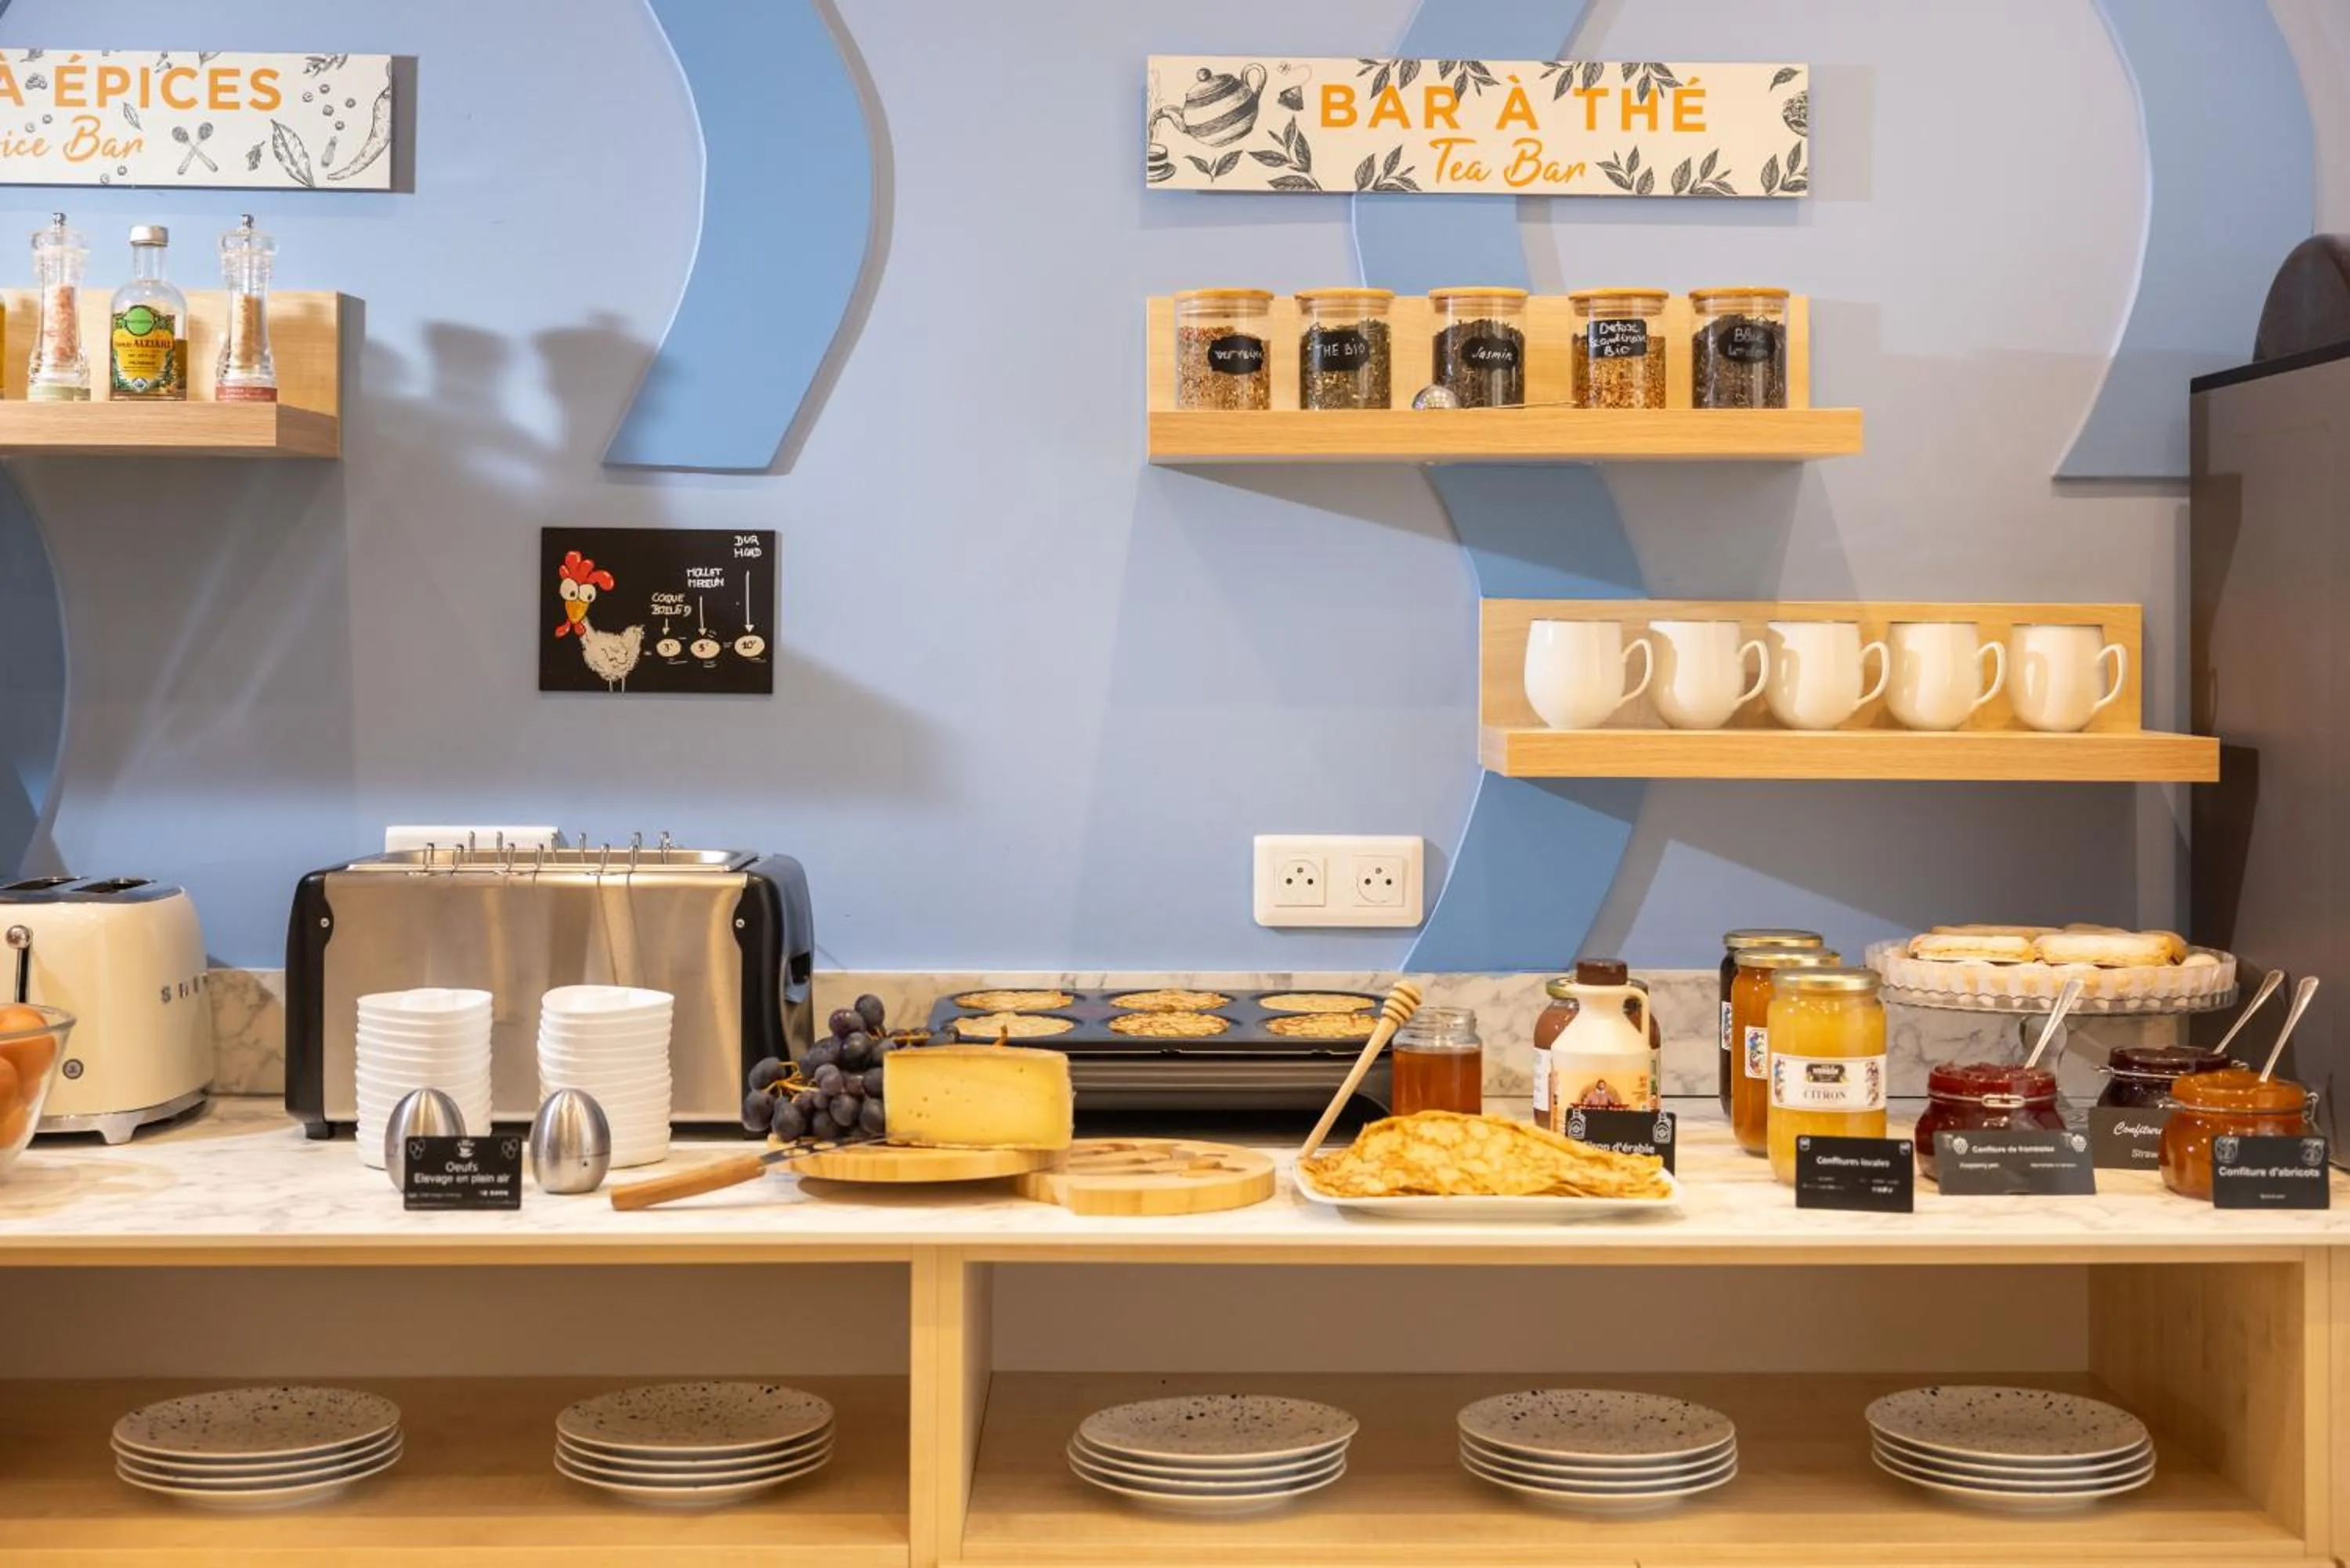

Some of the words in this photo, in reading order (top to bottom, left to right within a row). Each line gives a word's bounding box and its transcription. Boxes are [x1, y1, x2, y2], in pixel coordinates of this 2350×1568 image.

[54, 53, 282, 111] ÉPICES
[1320, 84, 1461, 129] BAR
[1495, 74, 1540, 131] À
[1573, 76, 1707, 132] THÉ
[0, 130, 51, 157] ice
[63, 114, 144, 164] Bar
[1428, 137, 1491, 184] Tea
[1503, 137, 1586, 187] Bar
[734, 535, 760, 546] DUR
[651, 592, 686, 603] COQUE
[1803, 1089, 1846, 1099] CITRON
[444, 1161, 479, 1172] Oeufs
[2218, 1165, 2266, 1177] Confiture
